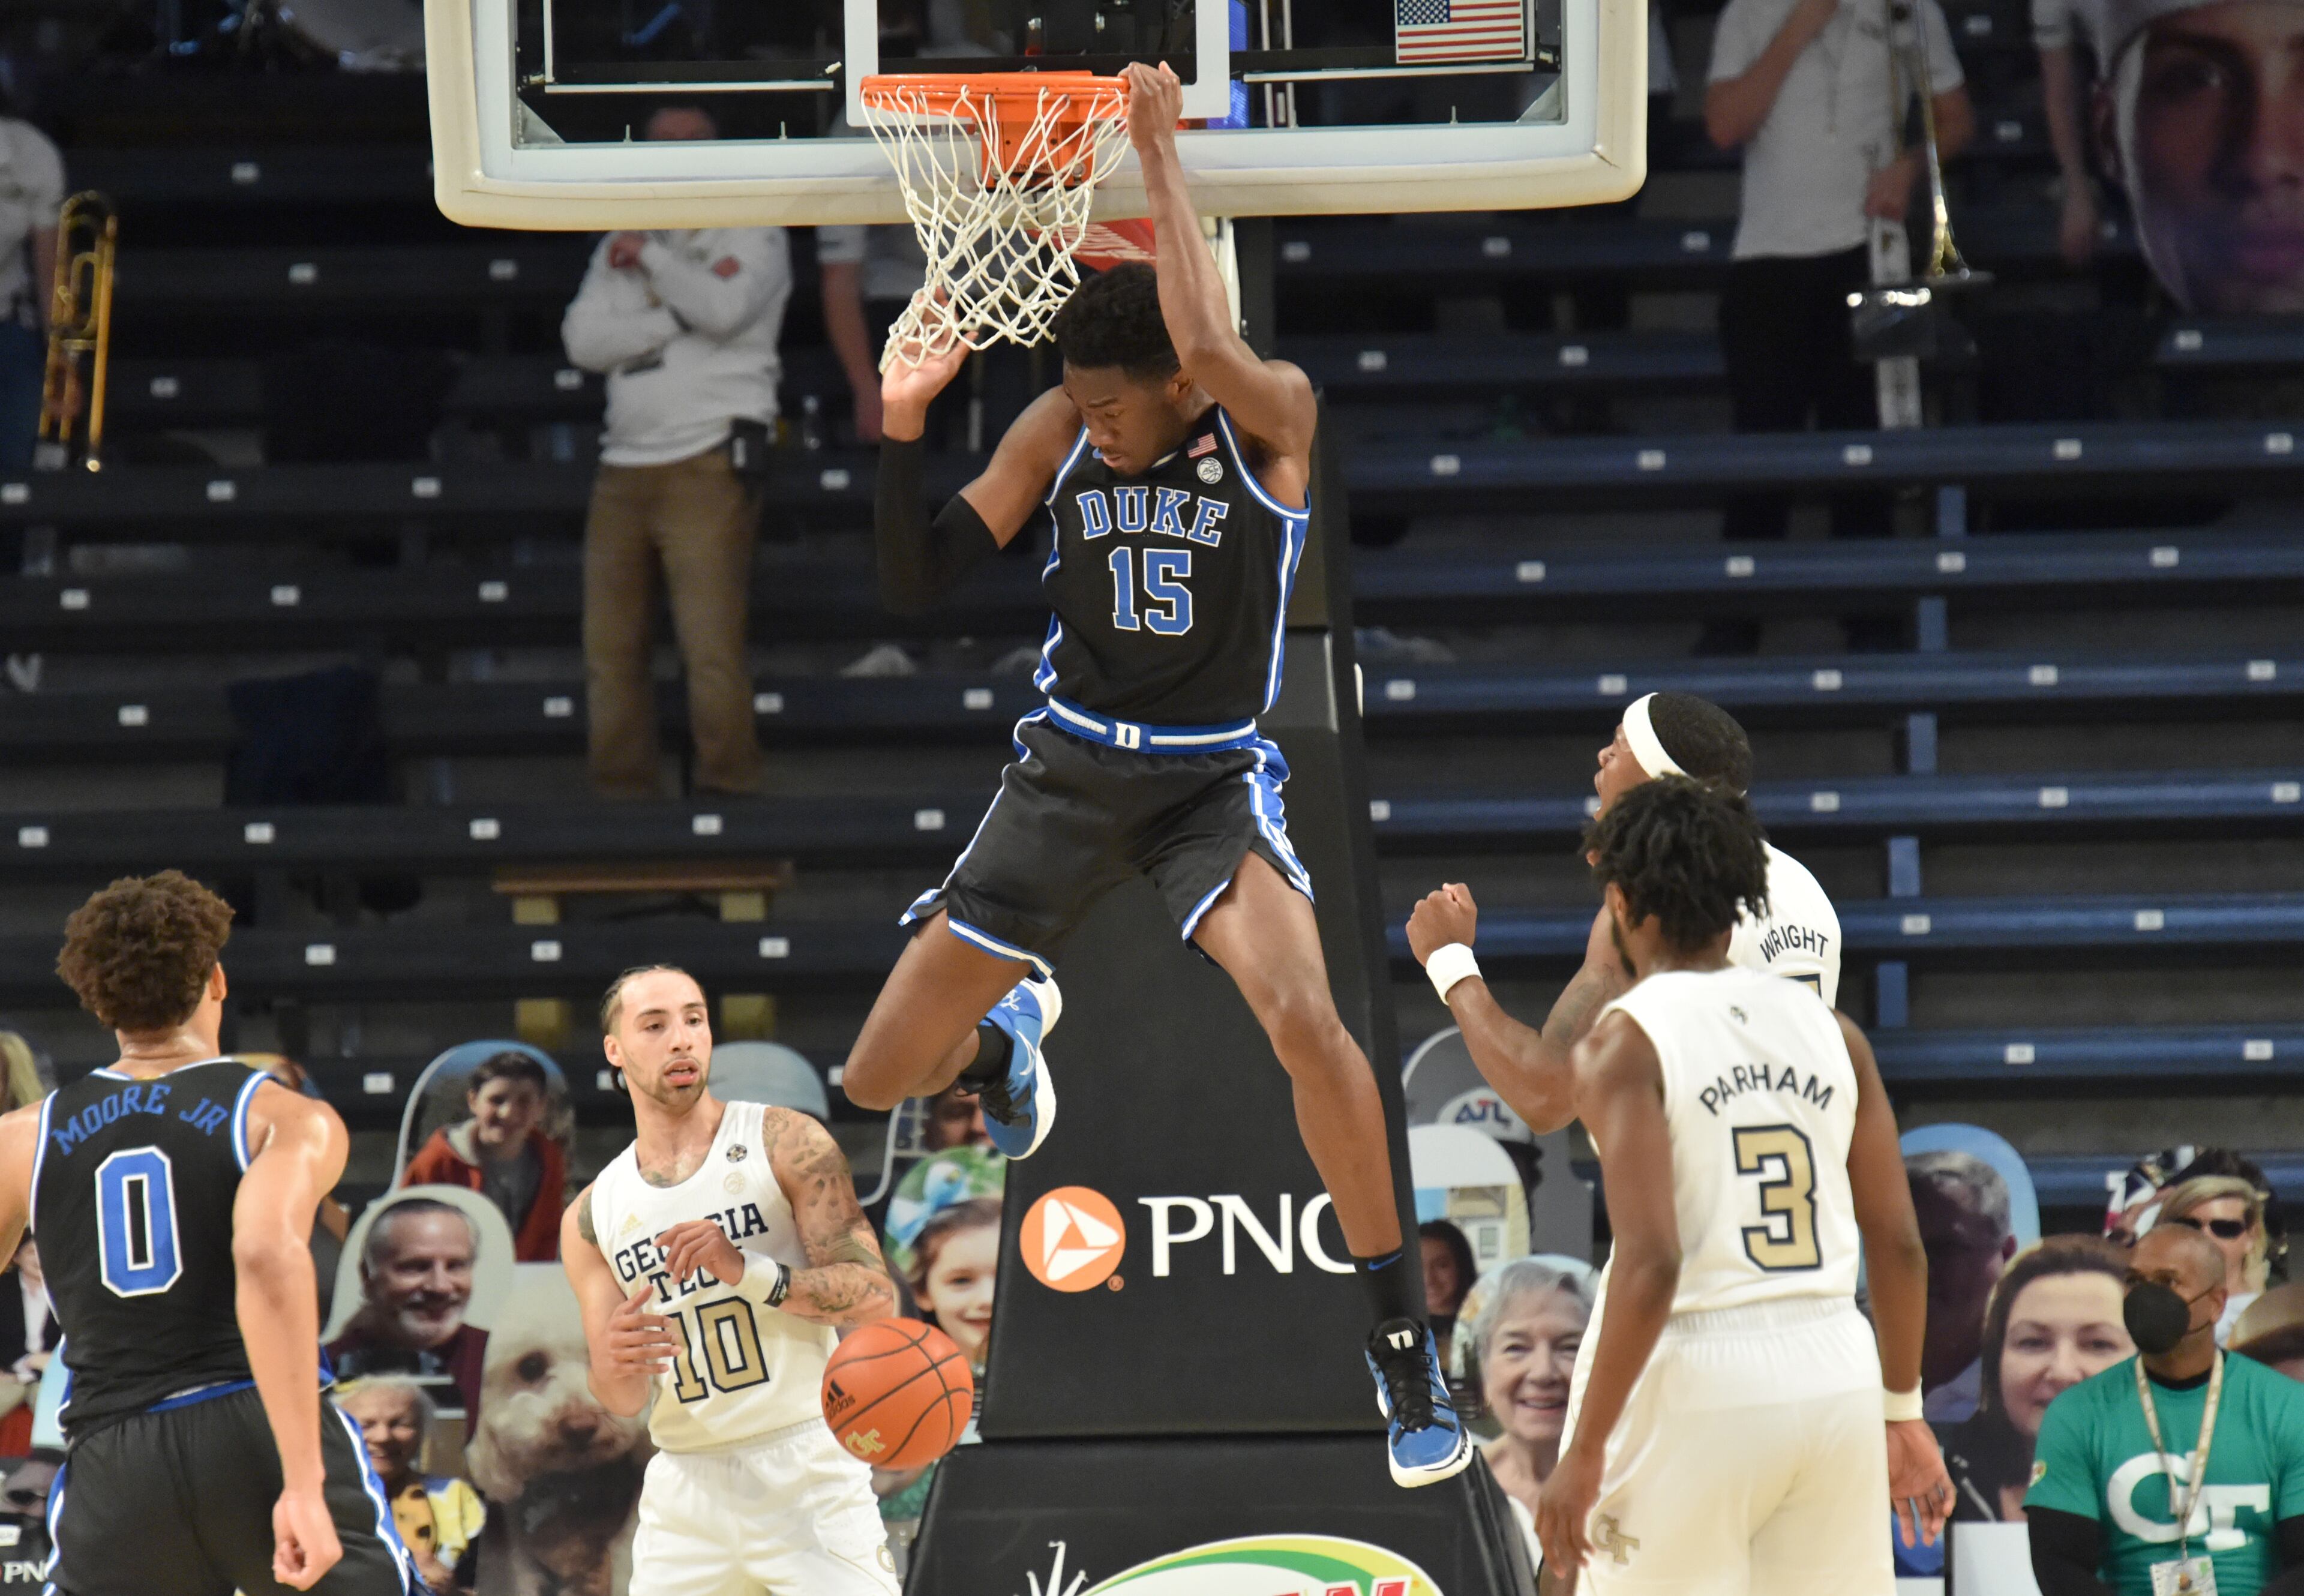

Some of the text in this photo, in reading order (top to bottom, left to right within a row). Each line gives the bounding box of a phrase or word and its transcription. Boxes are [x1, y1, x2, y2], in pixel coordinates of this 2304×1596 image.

[1076, 486, 1229, 547] DUKE
[1108, 546, 1193, 636] 15
[1114, 722, 1141, 749] D
[1760, 925, 1828, 964] WRIGHT
[51, 1084, 229, 1156] MOORE JR
[1699, 1064, 1835, 1116] PARHAM
[95, 1145, 184, 1298] 0
[1732, 1124, 1824, 1273] 3
[661, 1296, 770, 1403] 10
